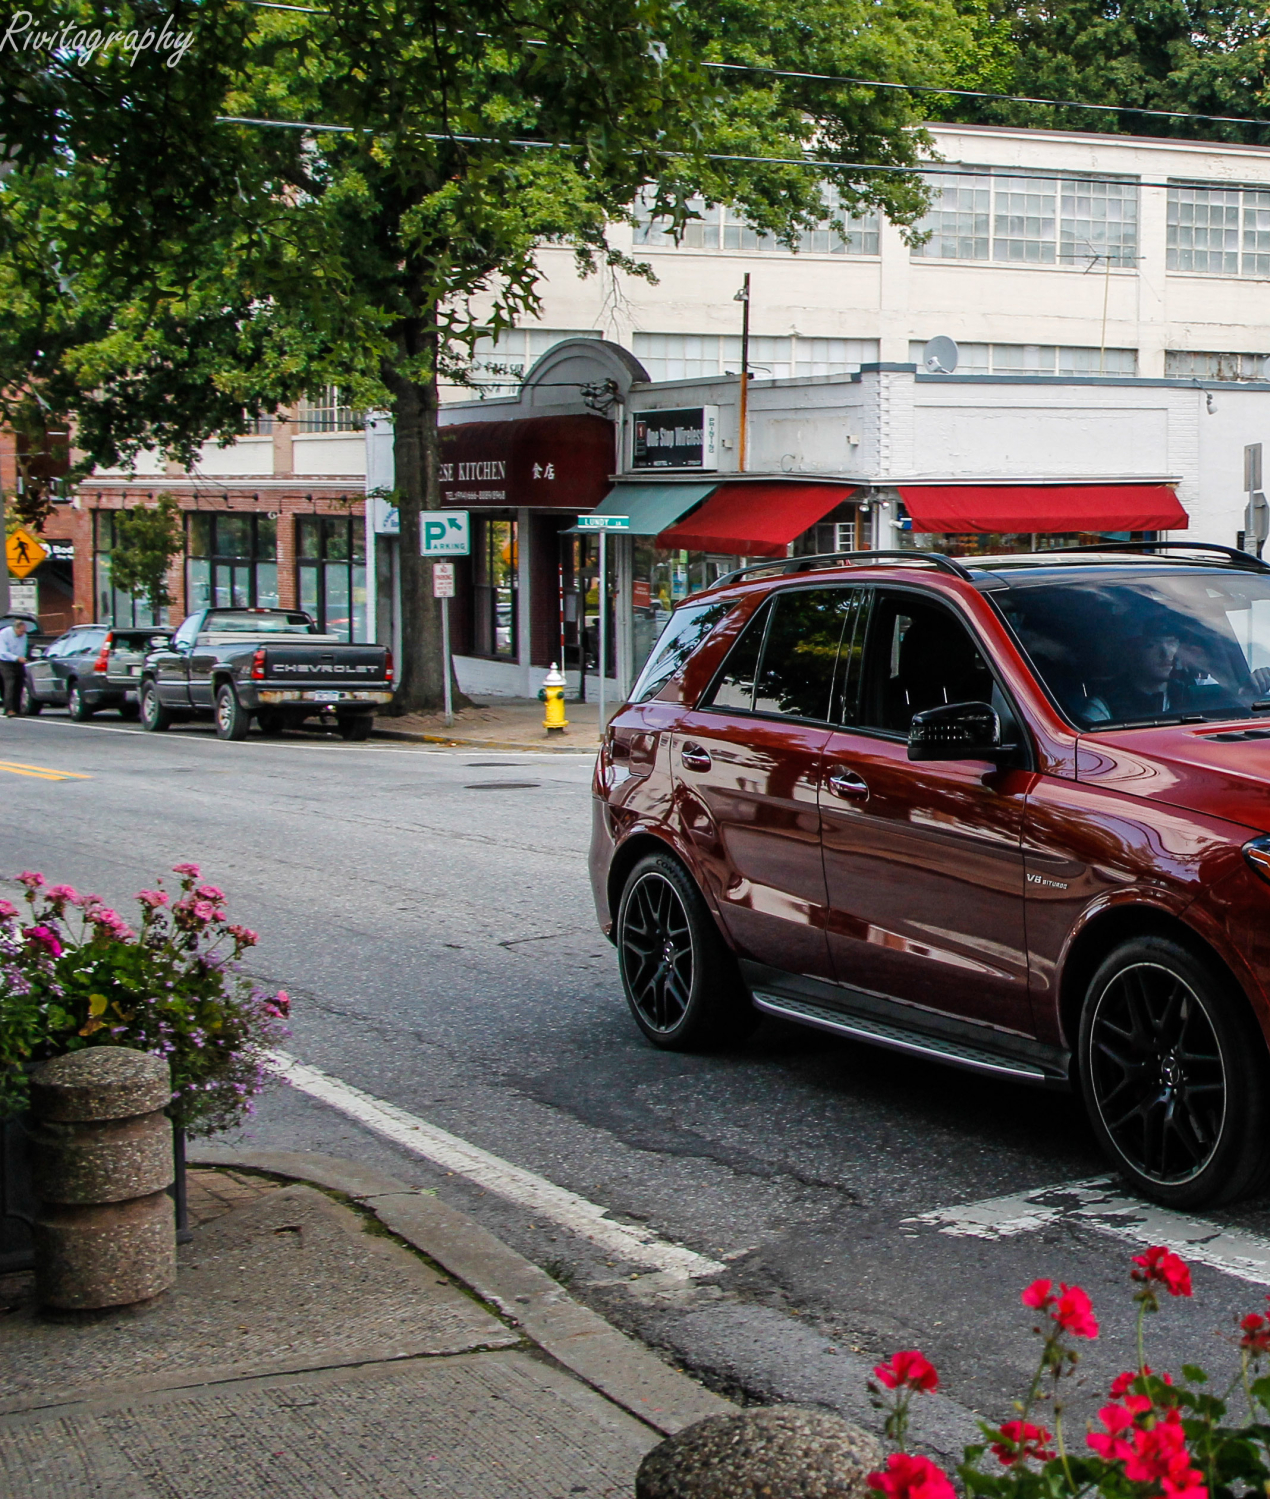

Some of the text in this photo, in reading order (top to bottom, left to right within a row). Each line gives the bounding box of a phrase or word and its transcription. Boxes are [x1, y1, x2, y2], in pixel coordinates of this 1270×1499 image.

[458, 461, 506, 480] KITCHEN
[584, 518, 610, 526] LUNDY
[272, 664, 379, 673] CHEVROLET
[1043, 880, 1067, 889] BITURBO
